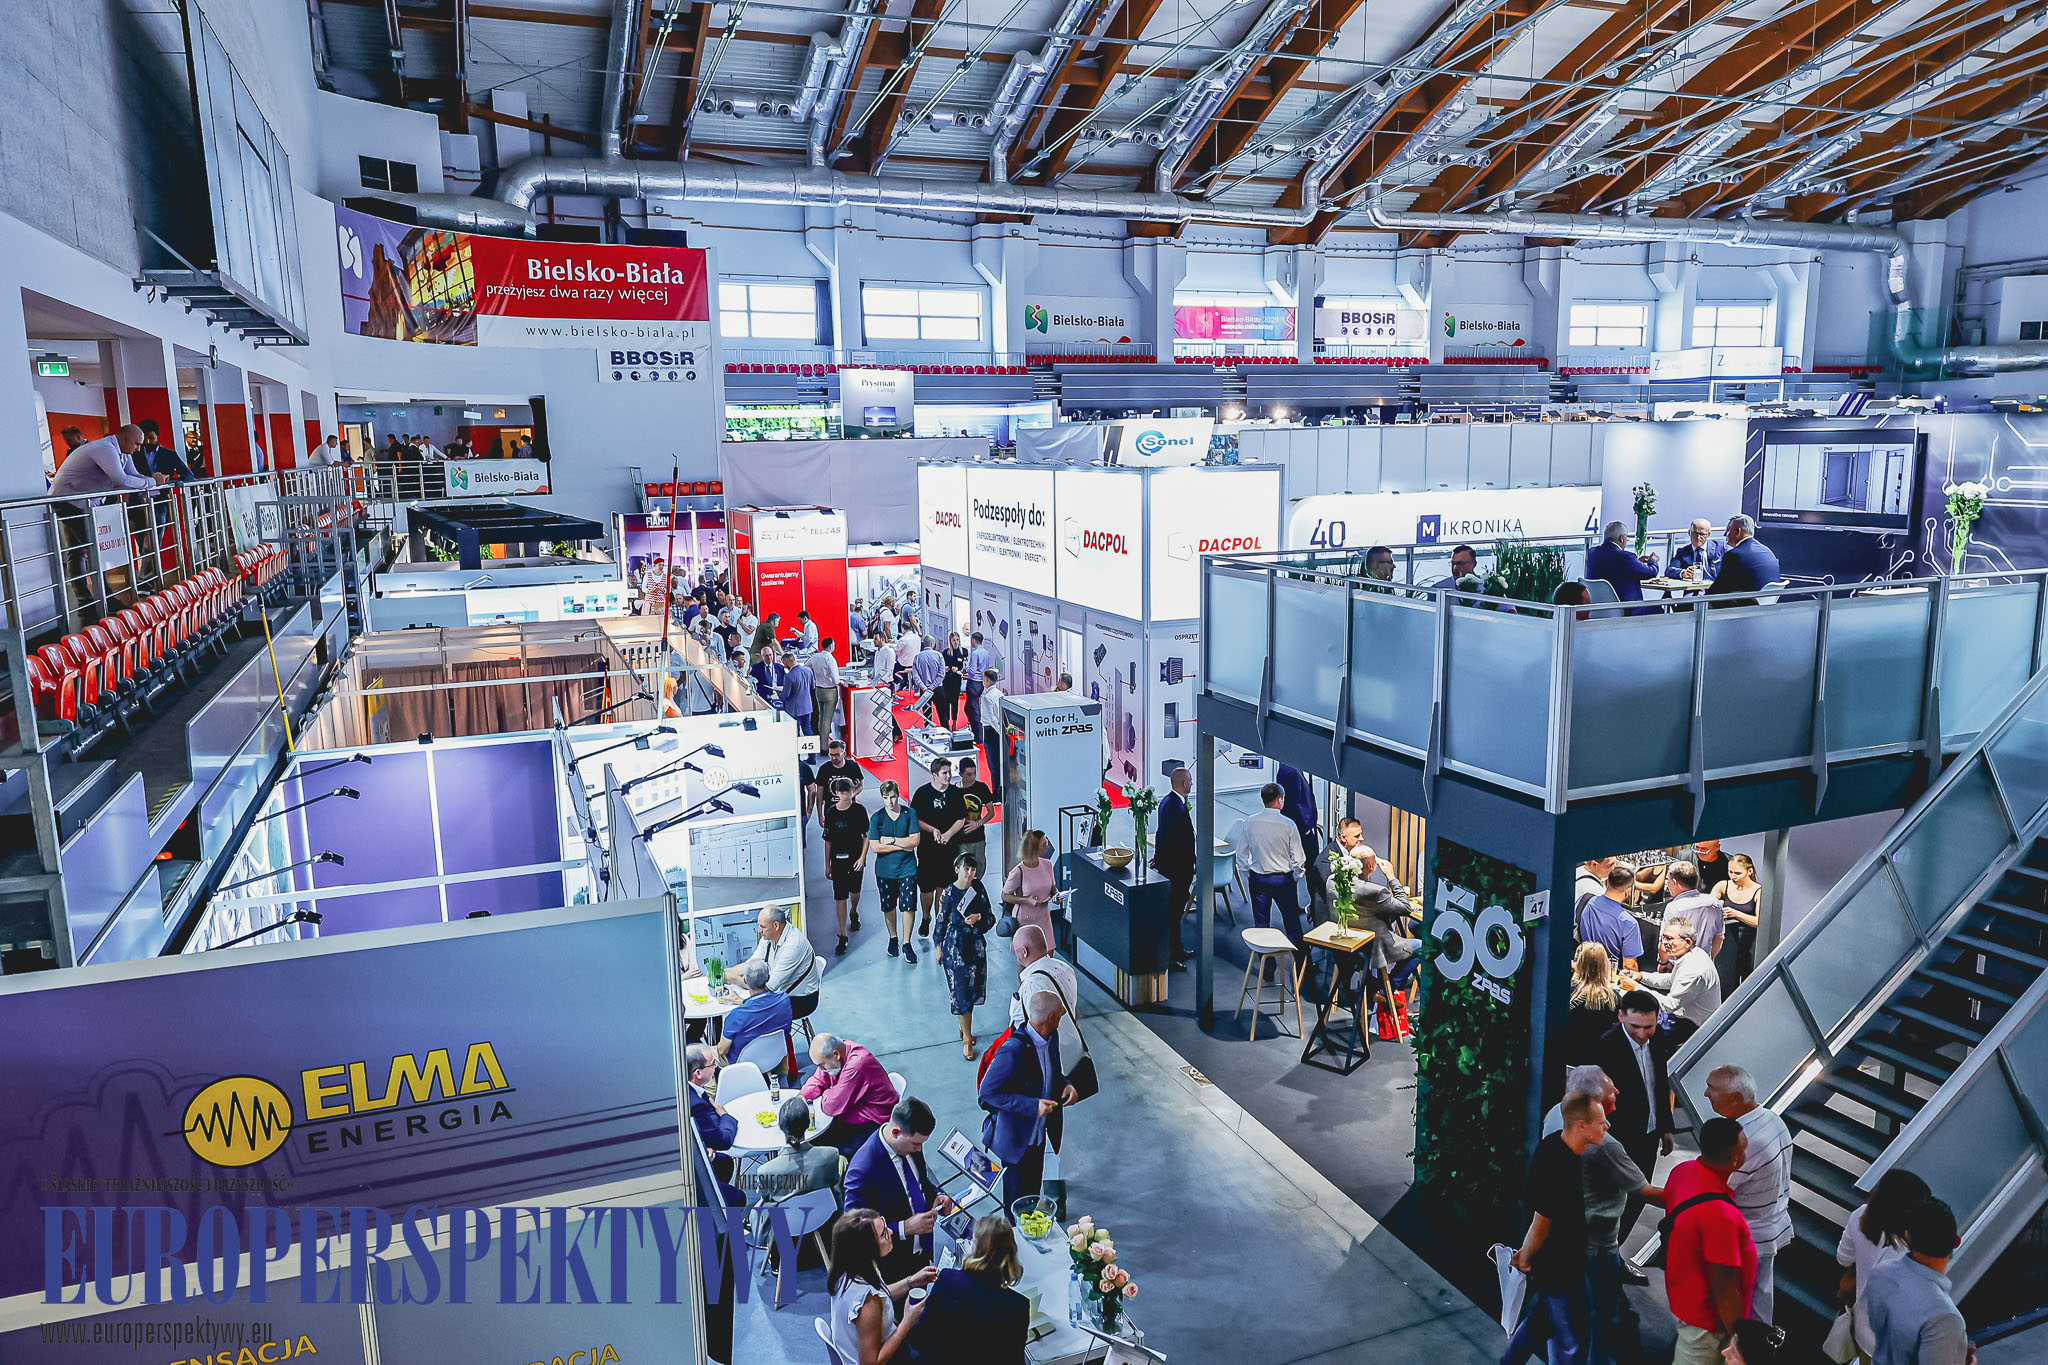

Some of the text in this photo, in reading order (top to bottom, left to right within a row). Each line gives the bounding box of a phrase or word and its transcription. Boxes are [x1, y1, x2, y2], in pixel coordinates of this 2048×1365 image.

[527, 258, 685, 285] Bielsko-Biała
[486, 284, 669, 305] przeżyjesz dwa razy więcej
[1053, 314, 1125, 327] Bielsko-Biała
[1341, 312, 1396, 325] BBOSiR
[1459, 320, 1521, 331] Bielsko-Biała
[525, 326, 696, 341] www.bielsko-biala.pl
[610, 350, 695, 366] BBOSiR
[1145, 436, 1194, 447] Sonel
[474, 470, 540, 483] Bielsko-Biała
[645, 516, 670, 527] FIAMM
[936, 510, 962, 528] DACPOL
[973, 498, 1045, 530] Podzespoły do:
[1310, 518, 1346, 549] 40
[1083, 529, 1128, 555] DACPOL
[1198, 537, 1262, 552] DACPOL
[1035, 716, 1050, 725] Go
[1051, 714, 1066, 724] for
[1035, 727, 1059, 738] with
[801, 742, 815, 751] 45
[1530, 901, 1544, 915] 47
[301, 1041, 509, 1121] ELMA
[307, 1100, 514, 1154] ENERGIA
